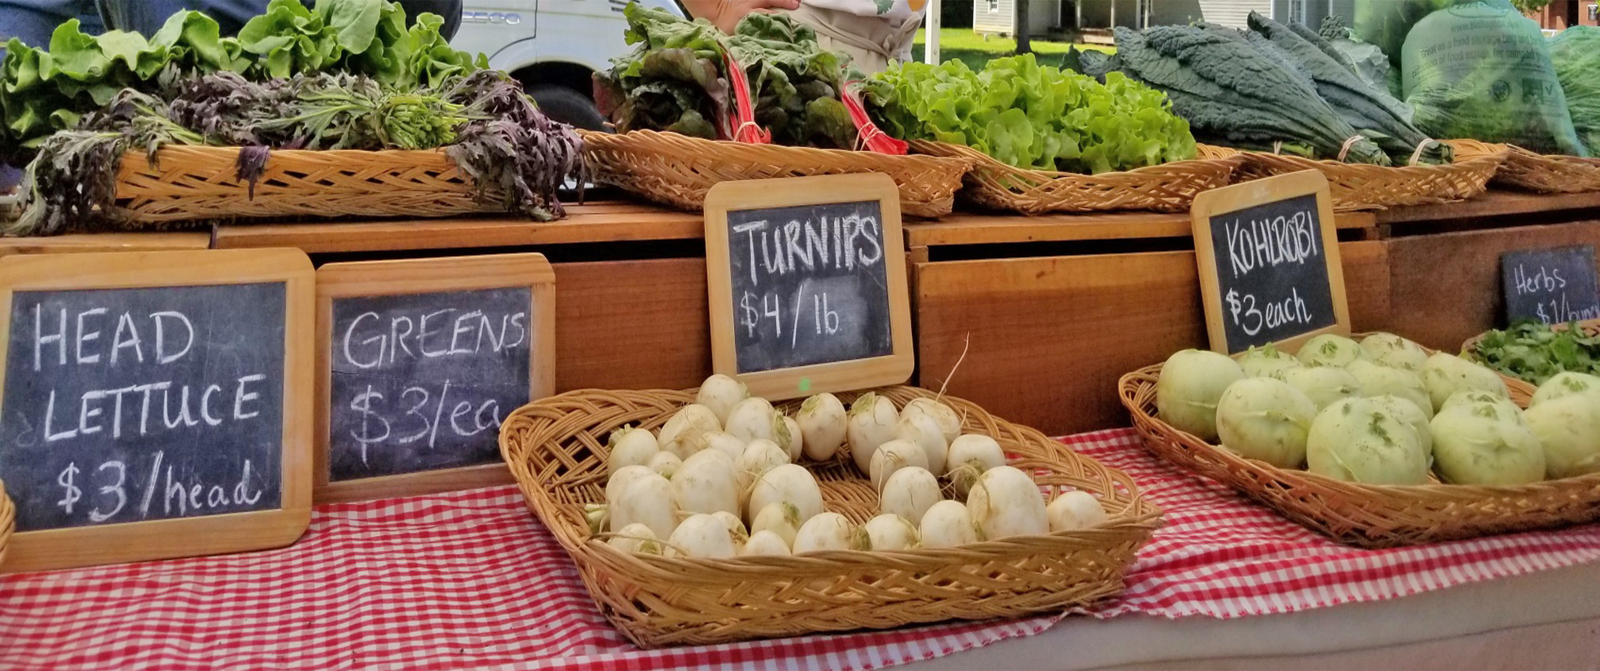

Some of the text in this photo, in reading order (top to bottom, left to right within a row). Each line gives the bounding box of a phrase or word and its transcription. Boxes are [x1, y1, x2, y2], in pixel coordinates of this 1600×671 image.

[733, 214, 882, 287] TURNIPS
[1514, 264, 1566, 295] Herbs
[34, 303, 195, 372] HEAD
[344, 308, 525, 369] GREENS
[44, 374, 267, 442] LETTUCE
